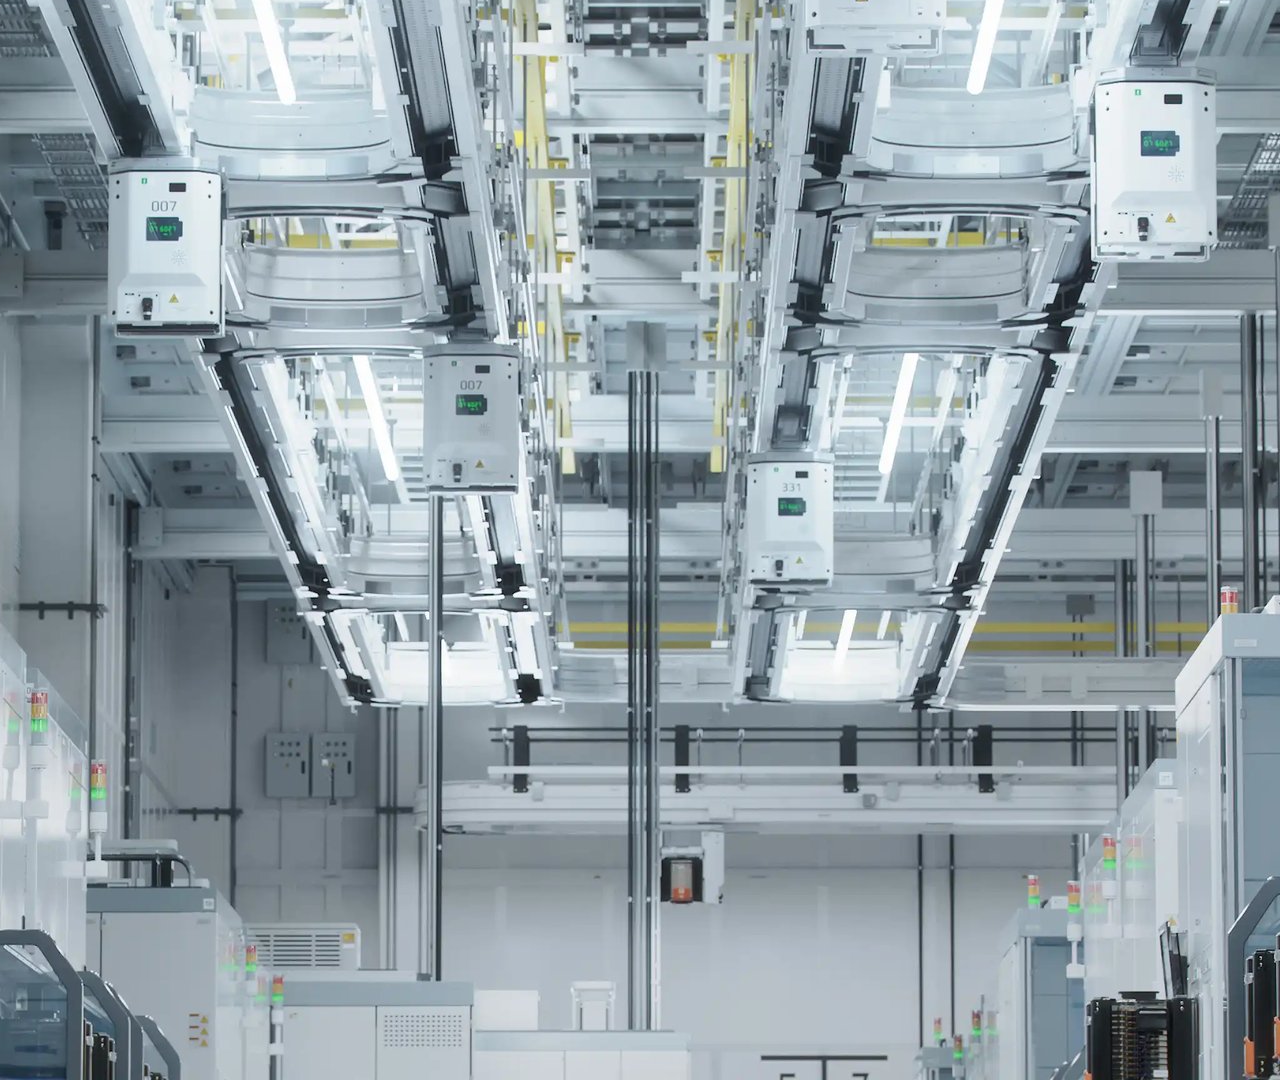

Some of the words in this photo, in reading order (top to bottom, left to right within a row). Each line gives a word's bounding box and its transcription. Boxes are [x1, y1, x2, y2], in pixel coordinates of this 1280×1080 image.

[151, 200, 177, 212] 007
[460, 380, 483, 390] 007
[782, 483, 801, 493] 331
